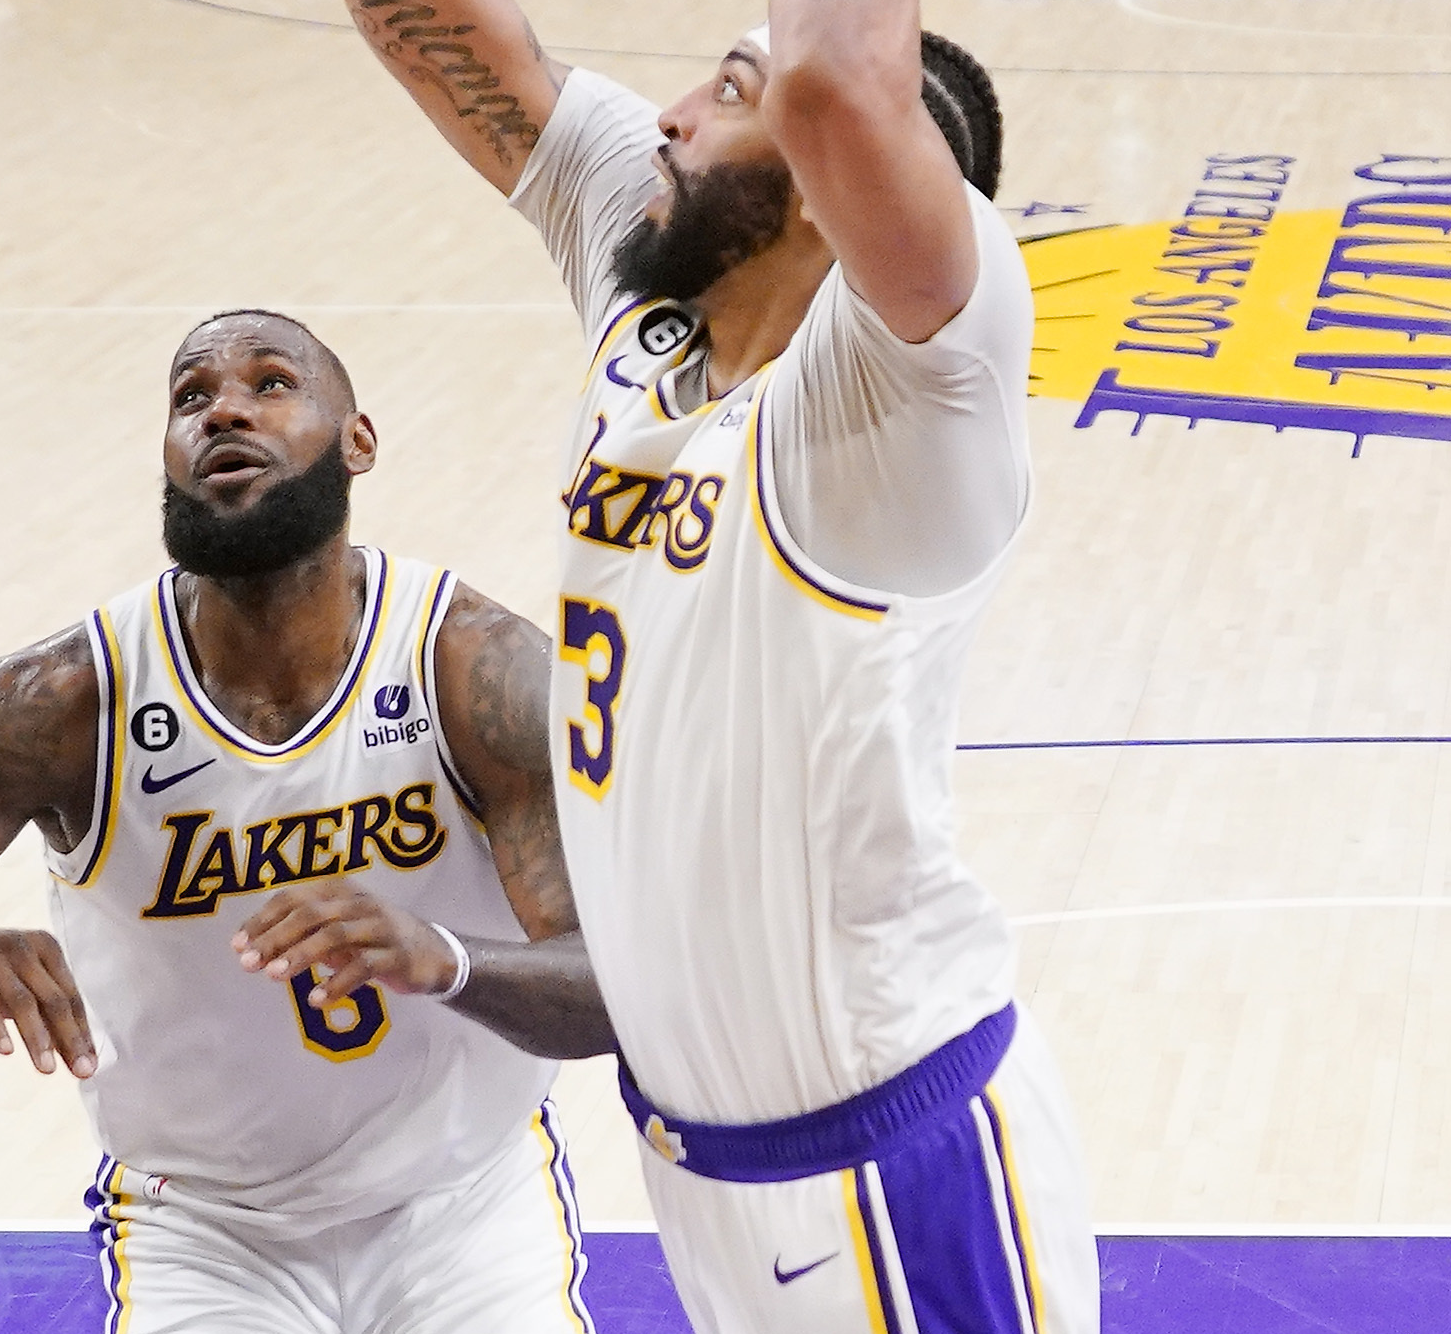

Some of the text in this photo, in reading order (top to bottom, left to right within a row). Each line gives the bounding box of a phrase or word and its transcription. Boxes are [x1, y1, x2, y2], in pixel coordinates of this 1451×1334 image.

[1112, 152, 1298, 358] LOS ANGELES
[644, 317, 690, 355] 6
[143, 708, 170, 746] 6
[363, 716, 431, 749] bibigo
[558, 592, 629, 804] 3
[140, 779, 449, 922] LAKERS
[286, 960, 392, 1065] 6
